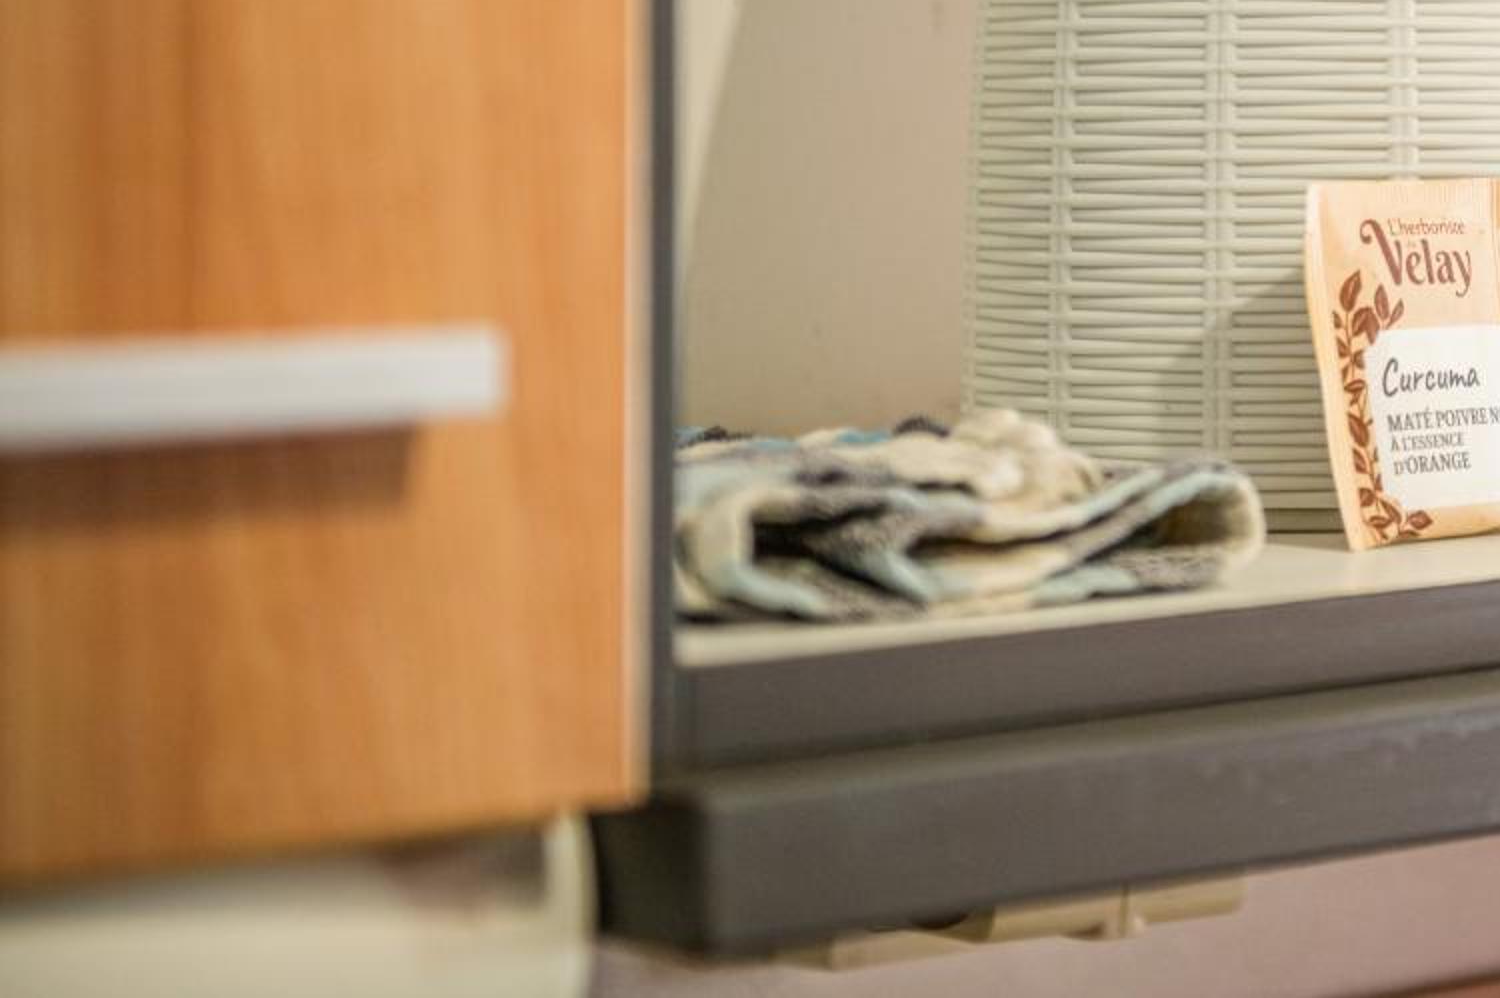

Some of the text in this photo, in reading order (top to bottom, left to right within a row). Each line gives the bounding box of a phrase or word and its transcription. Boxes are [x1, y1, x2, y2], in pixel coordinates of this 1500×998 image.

[1360, 218, 1472, 298] Velay
[1382, 357, 1480, 397] Curcuma
[1387, 405, 1433, 432] MATÉ
[1435, 406, 1488, 428] POIVRE
[1402, 432, 1465, 451] L'ESSENCE
[1393, 451, 1472, 476] D'ORANGE
